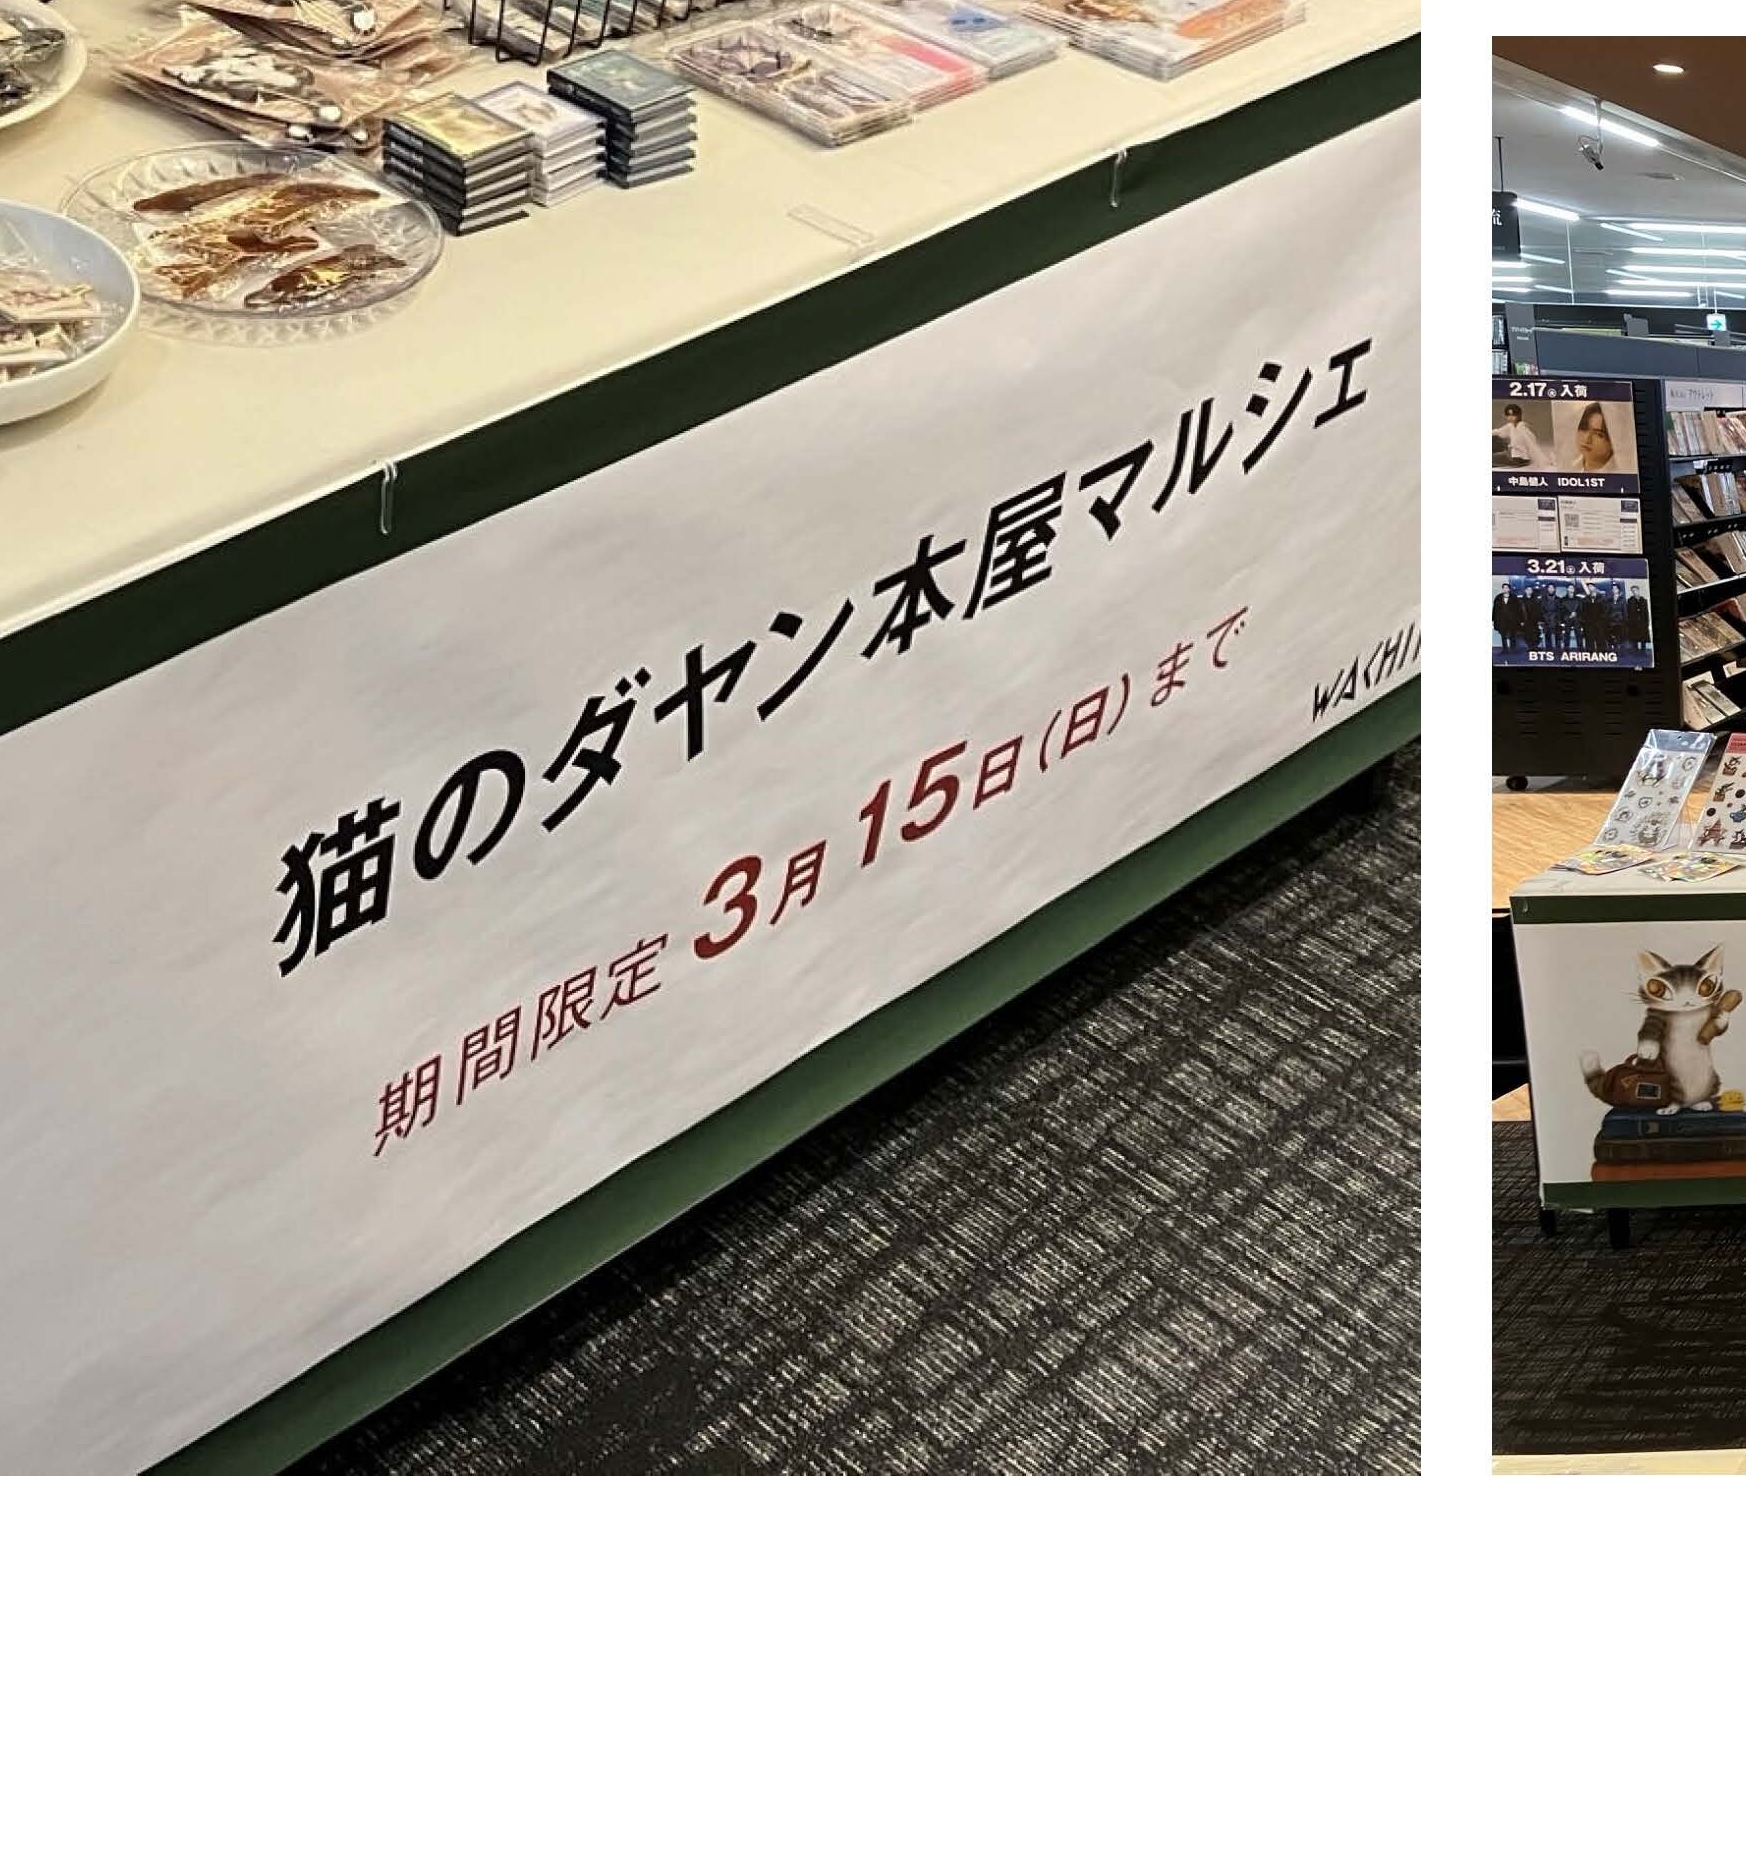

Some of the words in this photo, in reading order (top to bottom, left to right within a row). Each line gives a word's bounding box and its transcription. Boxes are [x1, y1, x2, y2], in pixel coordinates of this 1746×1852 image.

[1560, 384, 1587, 398] 入荷
[1557, 477, 1606, 487] IDOL1ST
[1579, 561, 1605, 573] 入荷
[276, 339, 1373, 977] 猫のダヤン本屋マルシェ
[1529, 651, 1554, 661] BTS
[1561, 651, 1617, 661] ARIRANG
